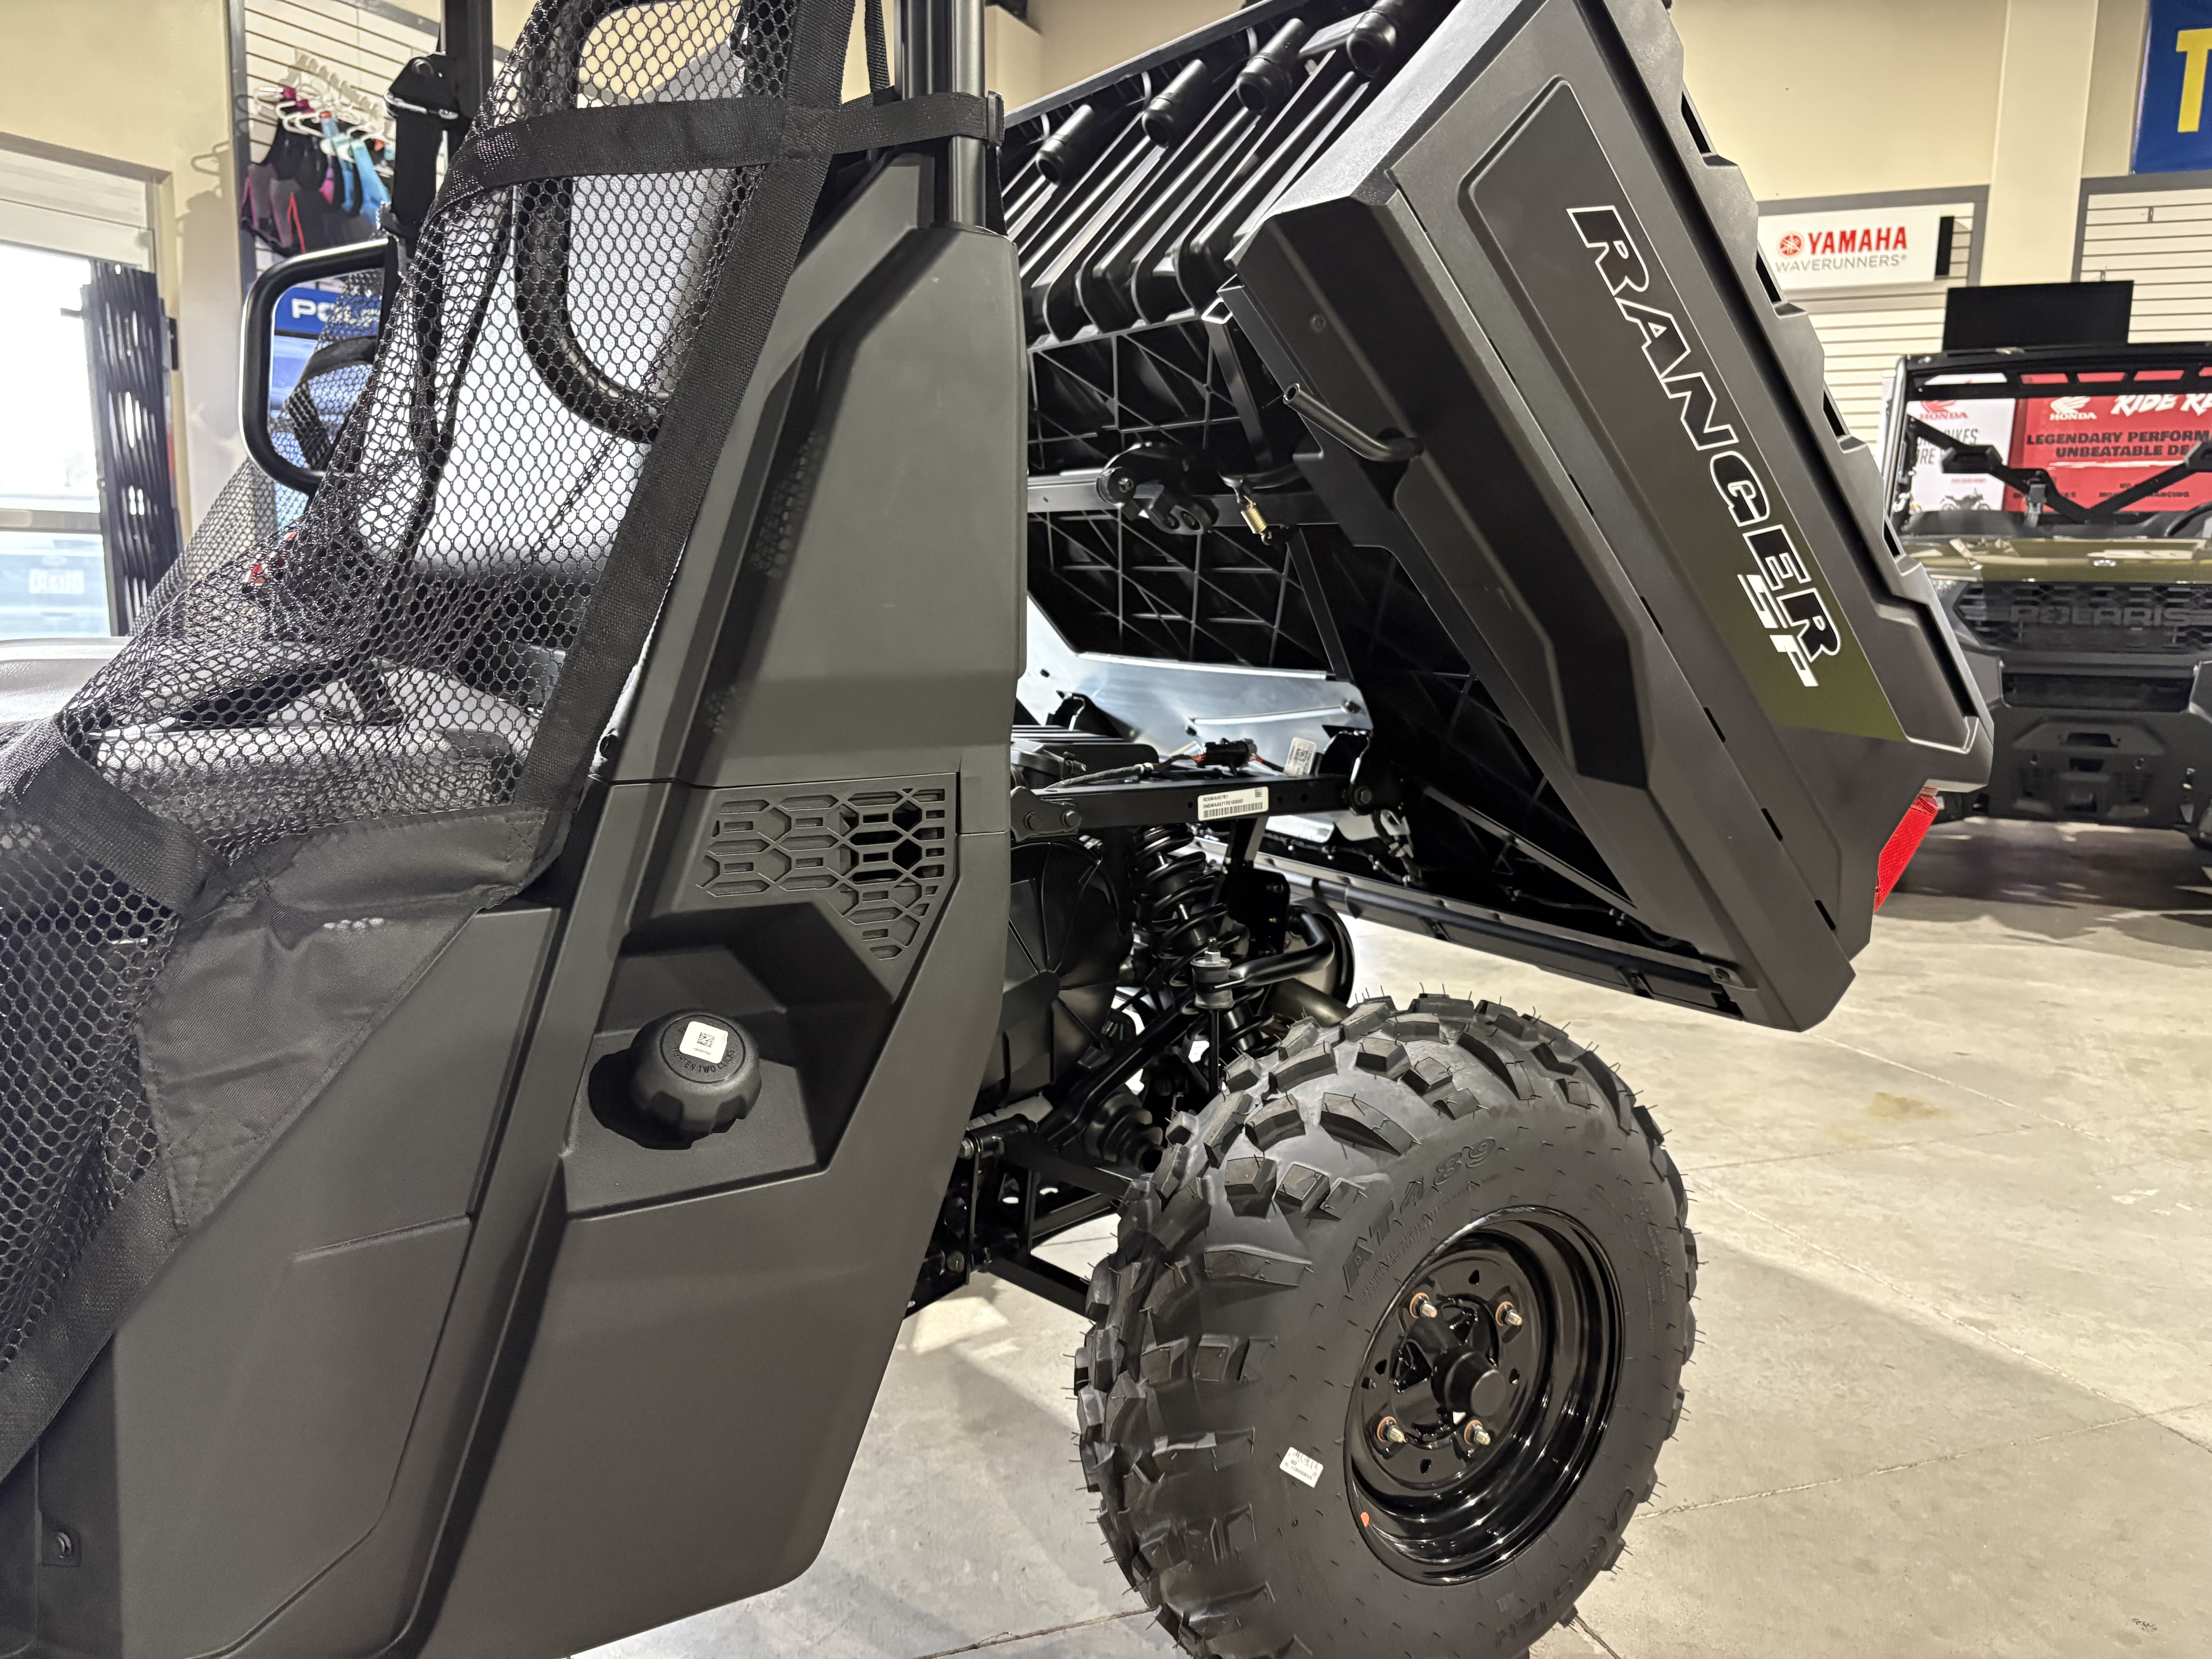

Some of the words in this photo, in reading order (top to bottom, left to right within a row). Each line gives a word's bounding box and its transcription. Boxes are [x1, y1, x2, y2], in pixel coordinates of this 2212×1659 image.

[1808, 226, 1907, 255] YAMAHA
[1920, 412, 1968, 421] HONDA
[2050, 412, 2097, 421] HONDA
[1566, 206, 1841, 663] RANGER
[2027, 432, 2123, 445] LEGENDARY
[2128, 430, 2212, 442] PERFORM
[2056, 445, 2162, 458] UNBEATABLE
[2167, 444, 2190, 456] DE
[2011, 605, 2193, 626] POLARIS
[698, 1065, 716, 1074] TWO
